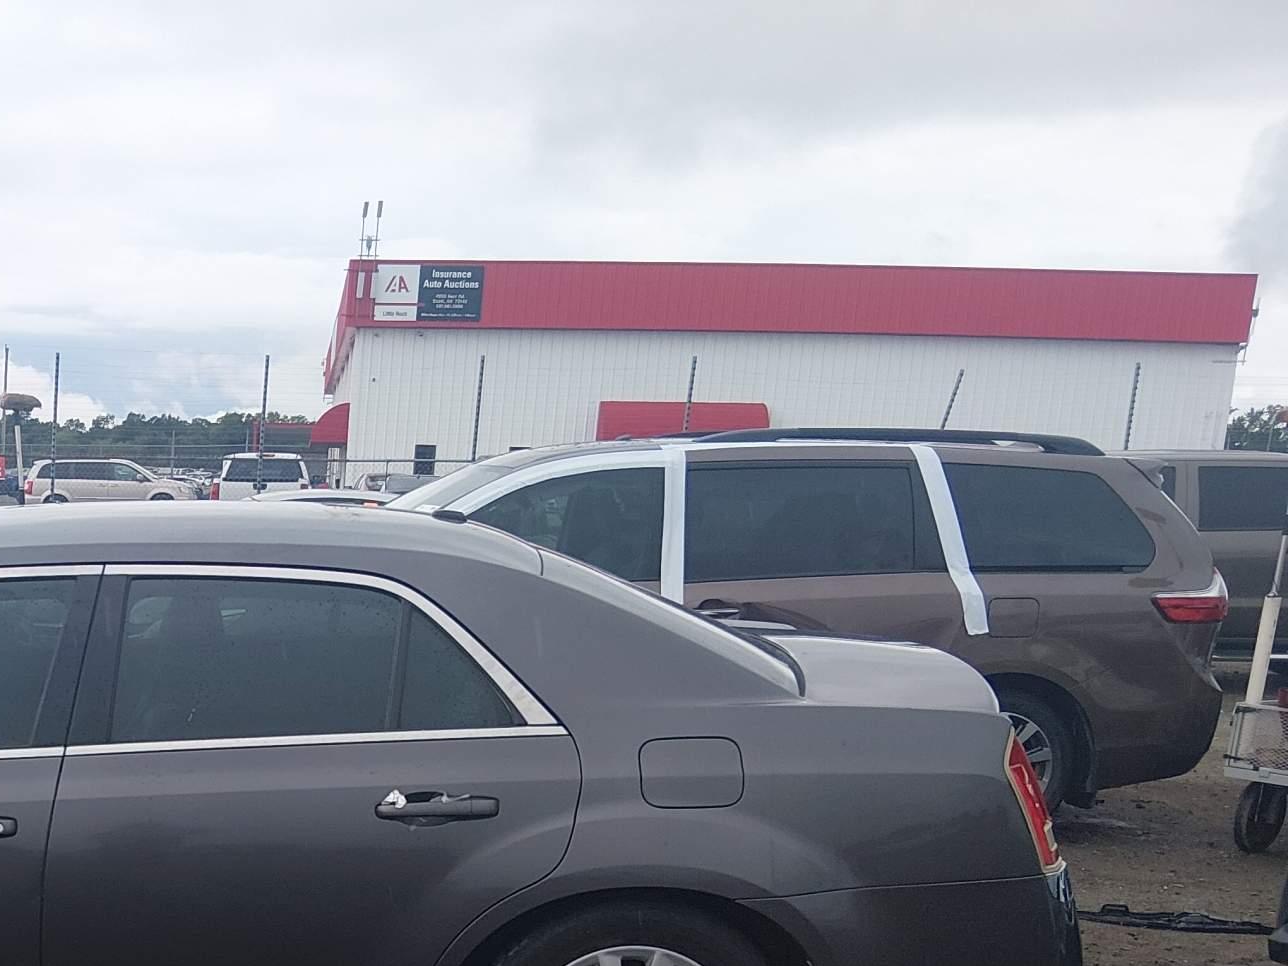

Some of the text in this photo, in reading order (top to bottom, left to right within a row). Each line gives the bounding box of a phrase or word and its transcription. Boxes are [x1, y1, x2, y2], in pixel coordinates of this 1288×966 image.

[432, 269, 472, 279] Insurance
[423, 280, 480, 289] Auto Auctions
